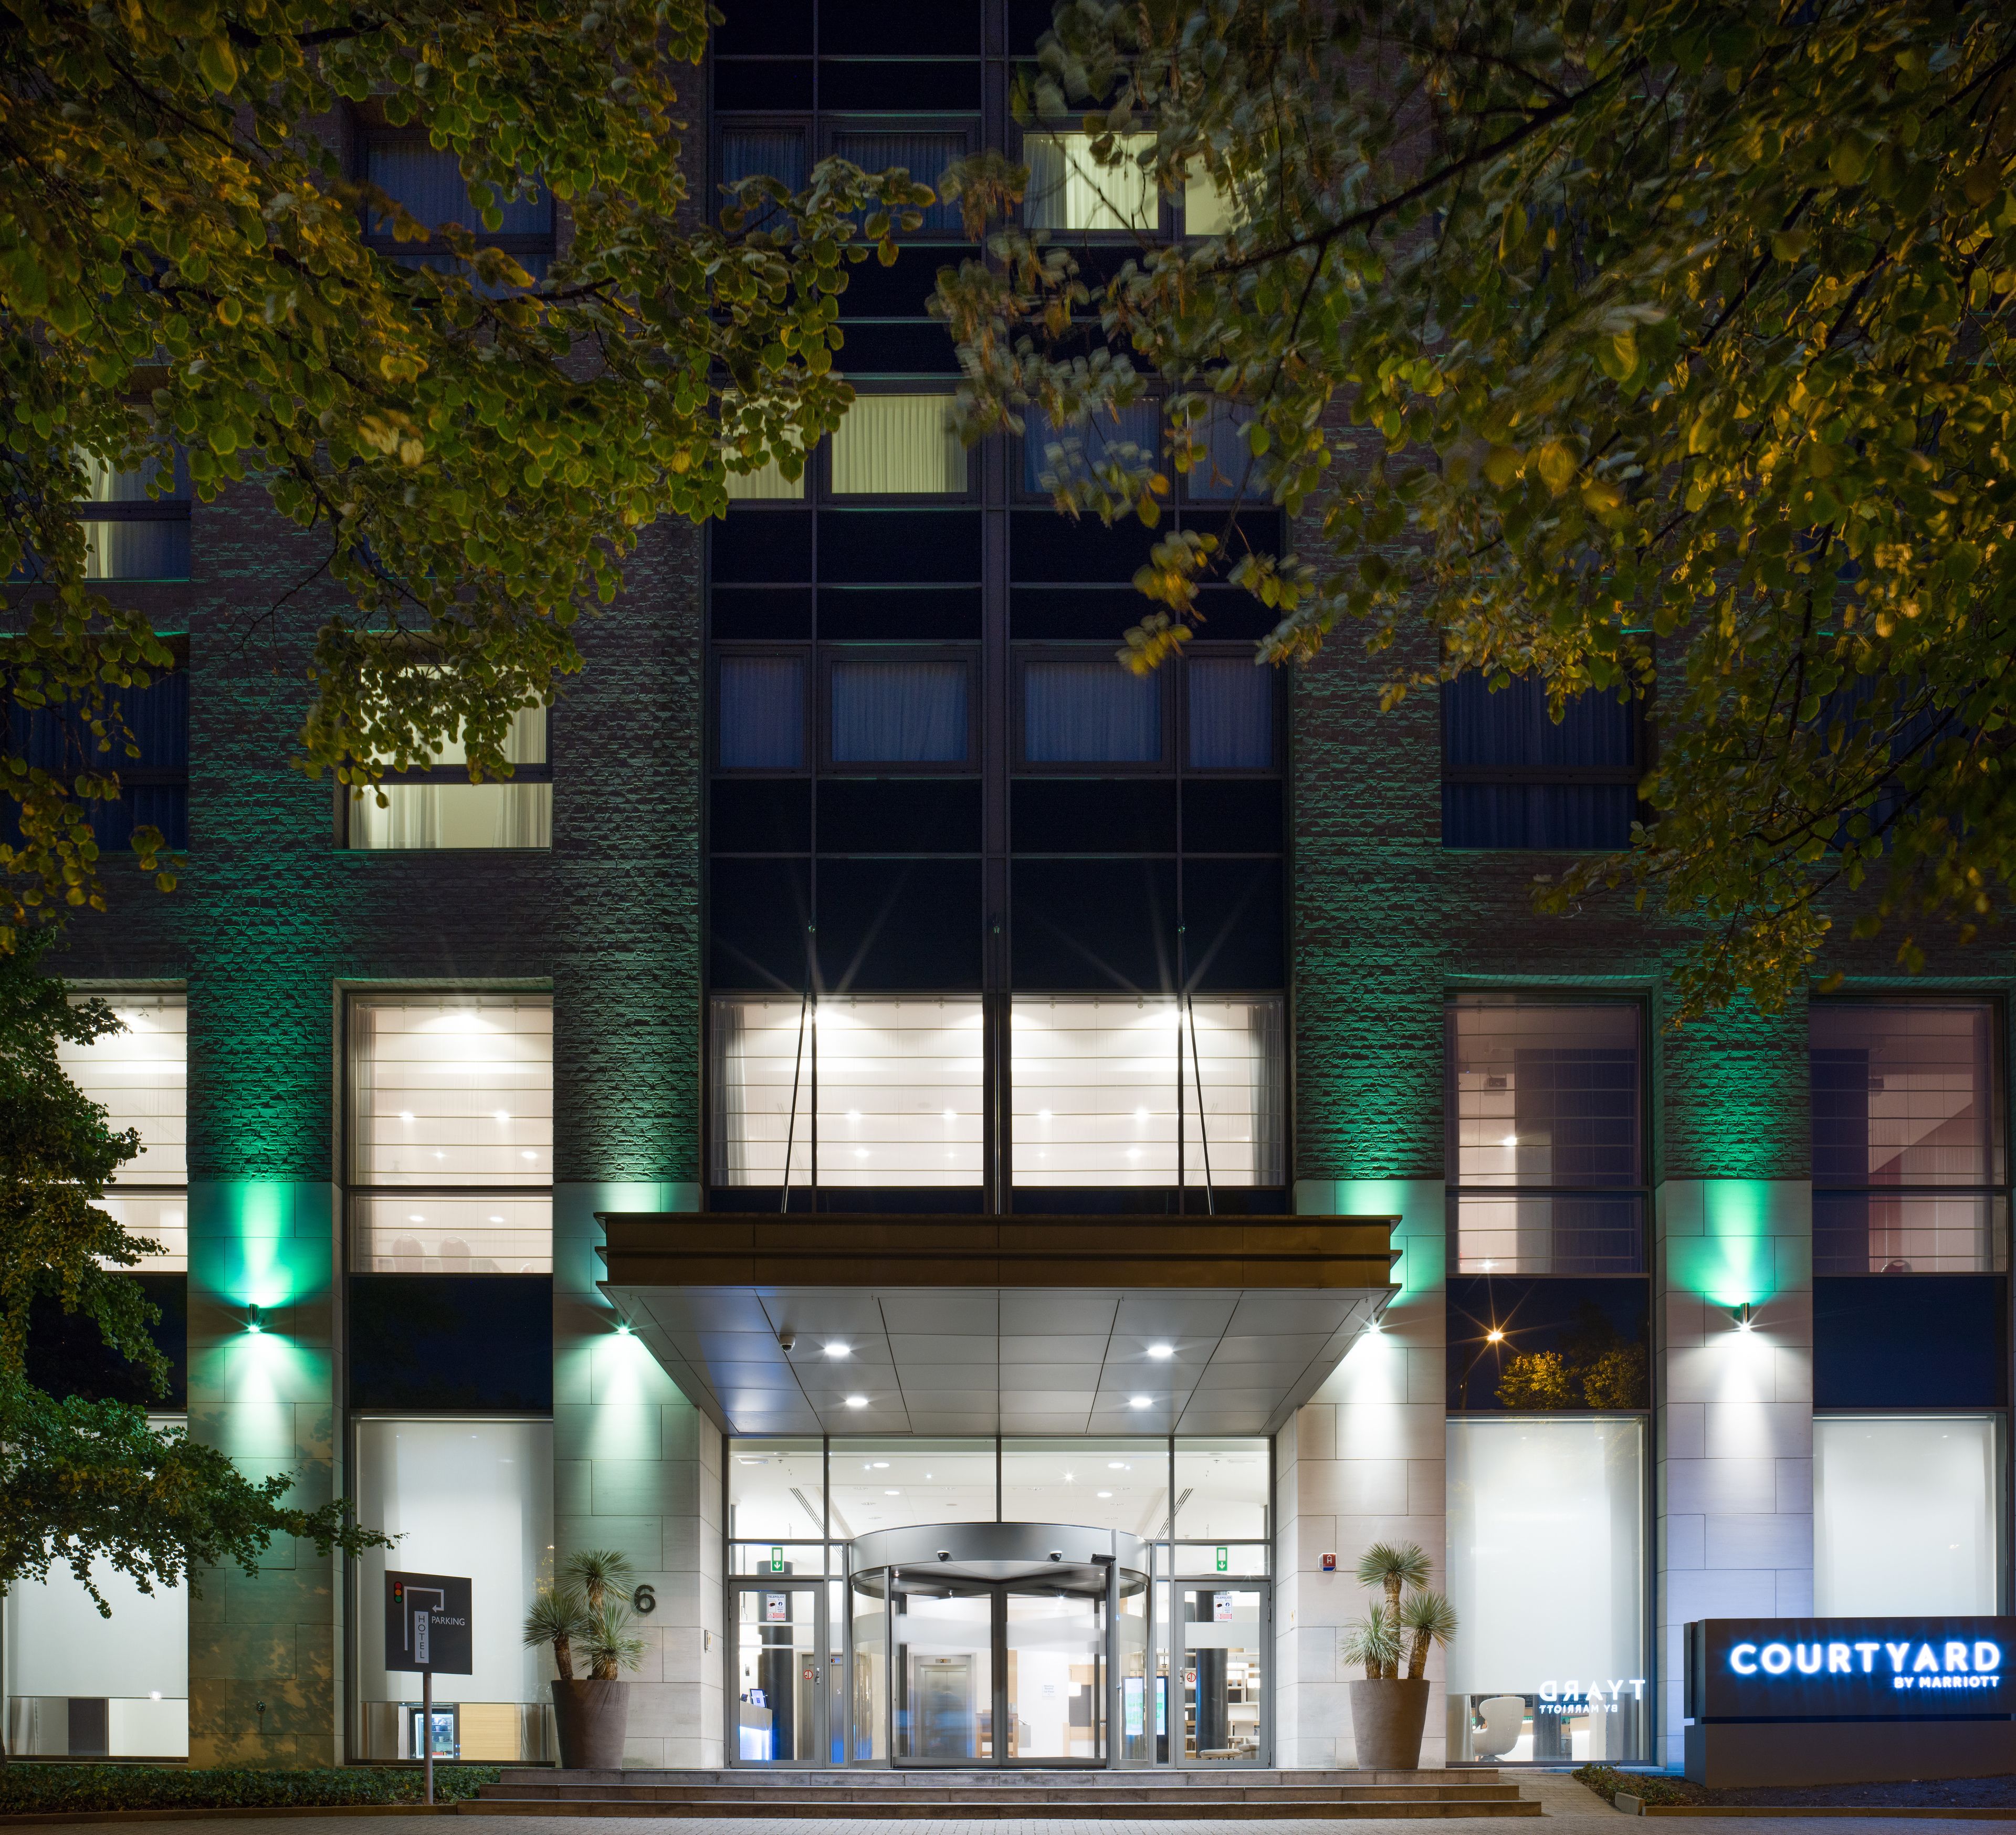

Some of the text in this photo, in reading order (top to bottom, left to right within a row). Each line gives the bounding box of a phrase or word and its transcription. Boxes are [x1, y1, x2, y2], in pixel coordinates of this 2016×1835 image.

[634, 1584, 656, 1613] 6
[432, 1616, 465, 1626] PARKING
[1730, 1642, 2000, 1674] COURTYARD
[1894, 1676, 1999, 1689] BY MARRIOTT
